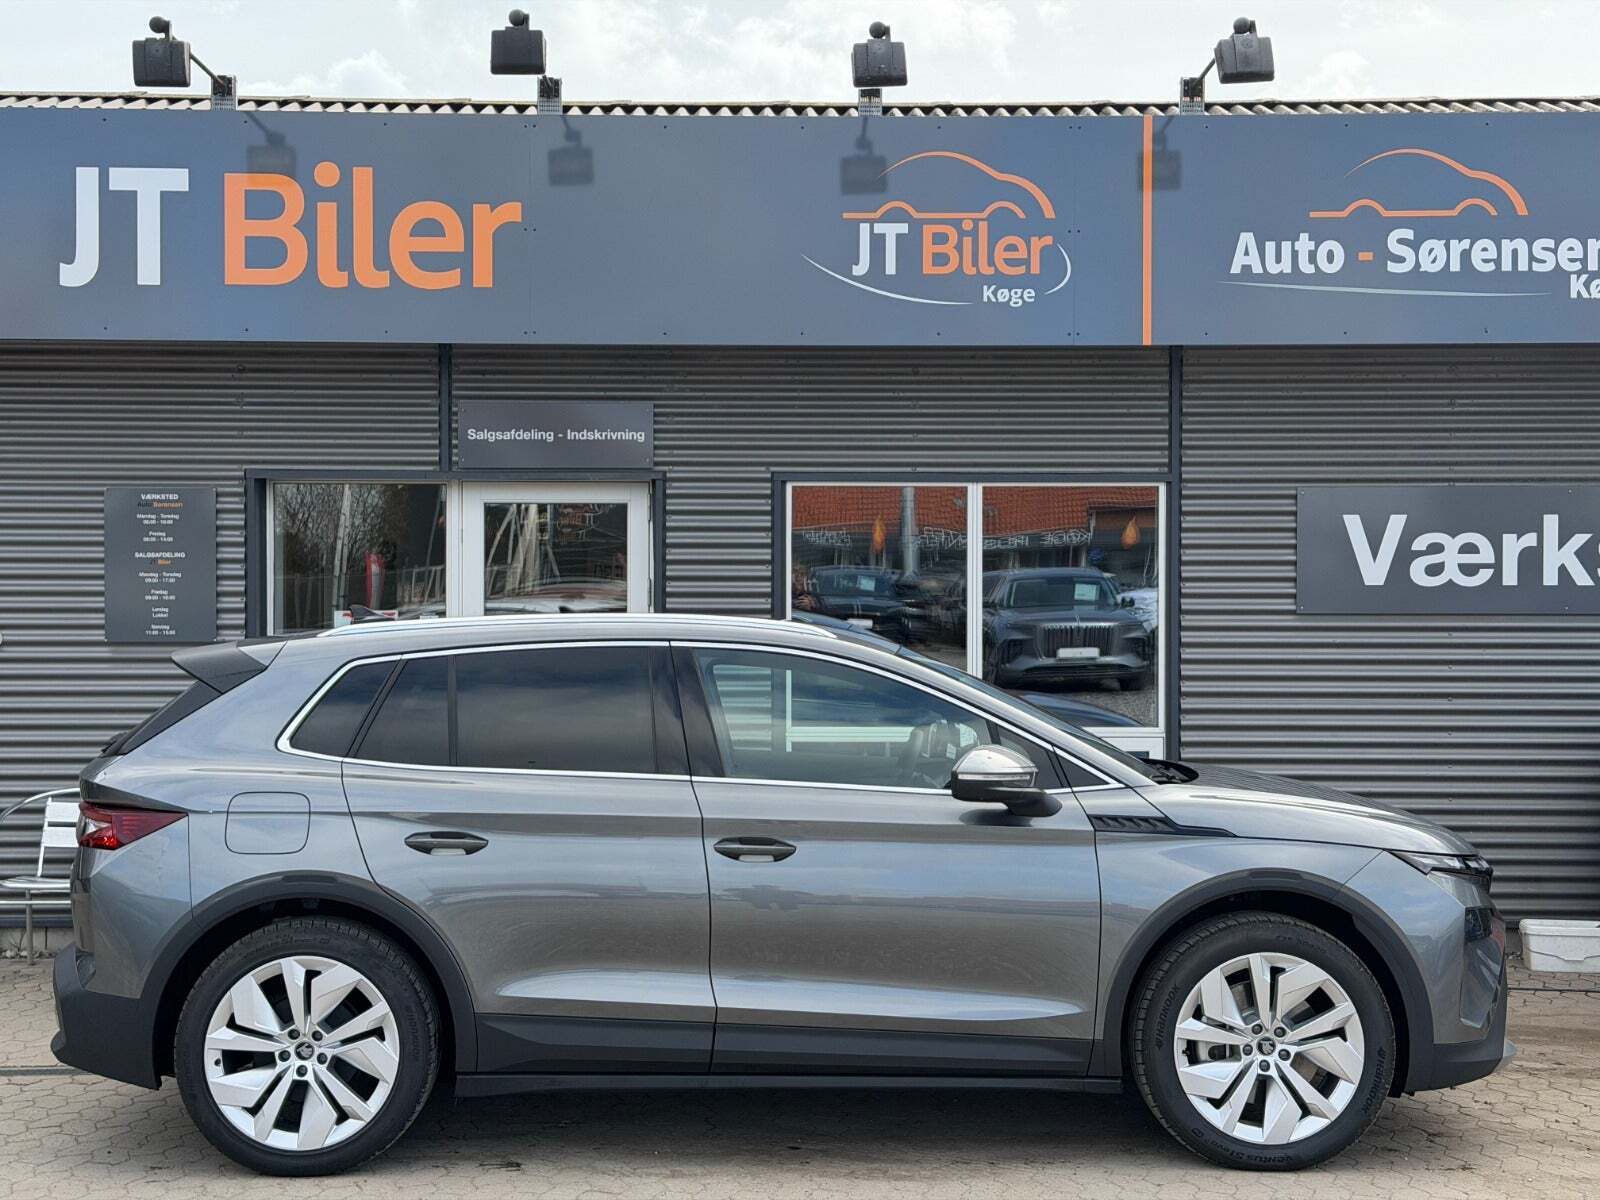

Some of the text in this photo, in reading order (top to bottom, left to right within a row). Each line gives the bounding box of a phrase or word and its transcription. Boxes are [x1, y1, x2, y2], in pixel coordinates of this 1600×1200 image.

[59, 161, 522, 290] JT Biler
[852, 219, 1053, 276] JT Biler
[1229, 231, 1345, 274] Auto
[982, 285, 1036, 307] Køge
[467, 428, 554, 442] Salgsafdeling
[567, 428, 645, 442] Indskrivning
[1343, 514, 1600, 587] Værk
